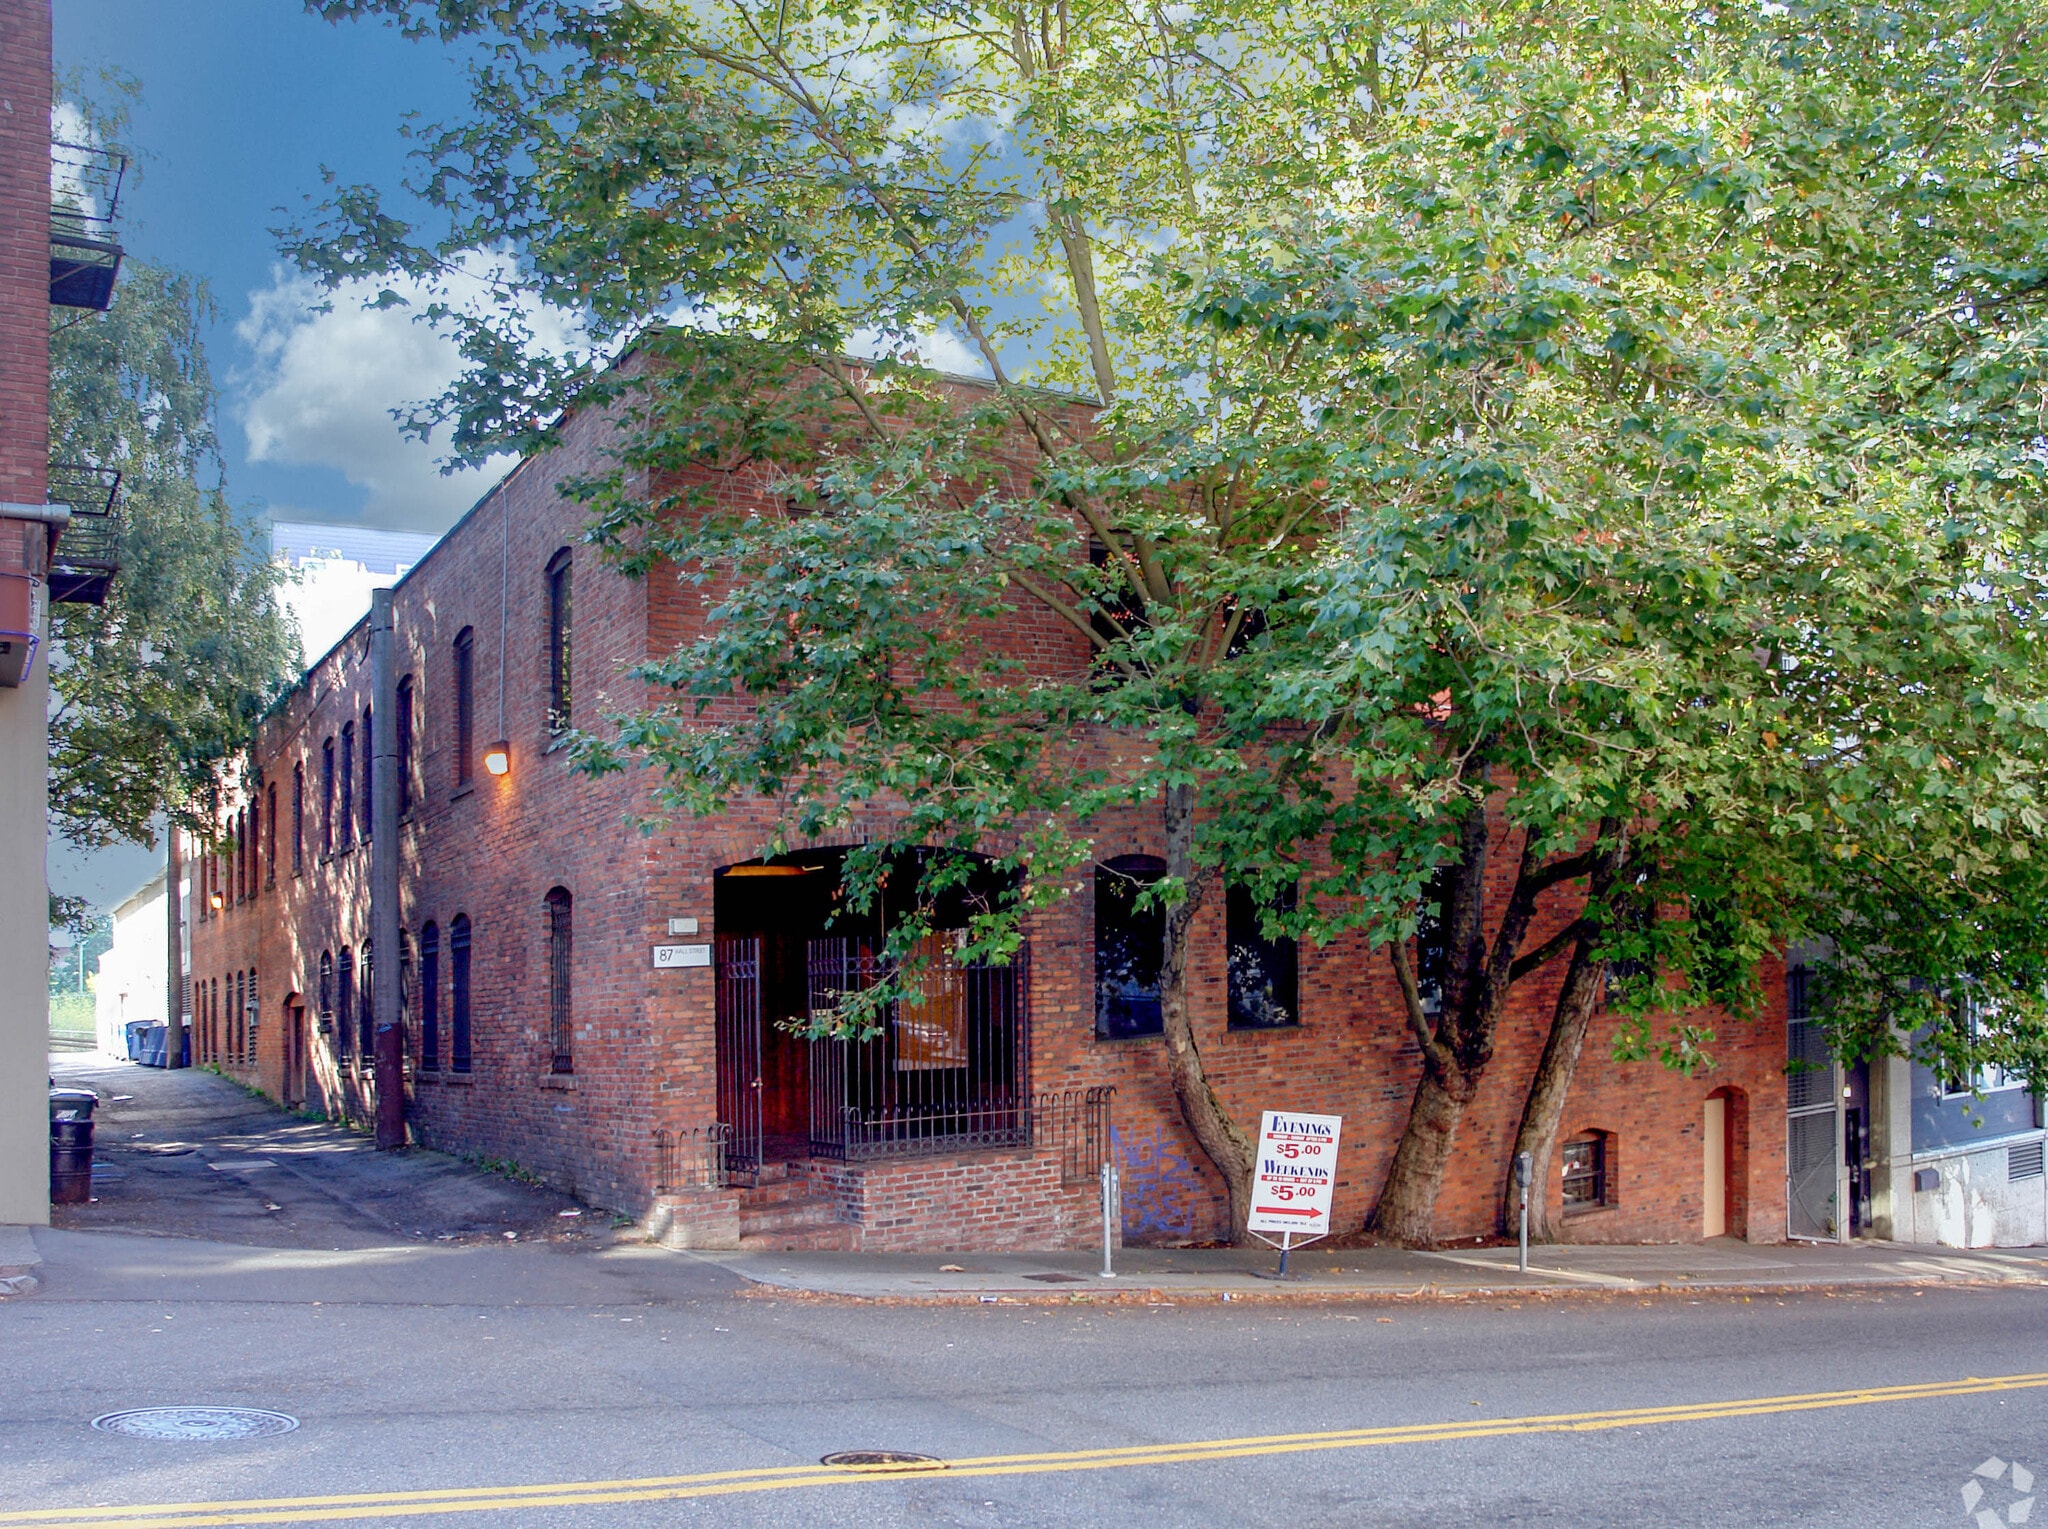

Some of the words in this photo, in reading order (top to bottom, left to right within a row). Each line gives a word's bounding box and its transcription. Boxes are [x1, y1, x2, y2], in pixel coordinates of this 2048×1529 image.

[659, 948, 674, 962] 87
[1272, 1115, 1332, 1135] EVENINGS
[1276, 1143, 1321, 1159] $5.00
[1264, 1159, 1329, 1177] WEEKENDS
[1270, 1185, 1316, 1201] $5.00
